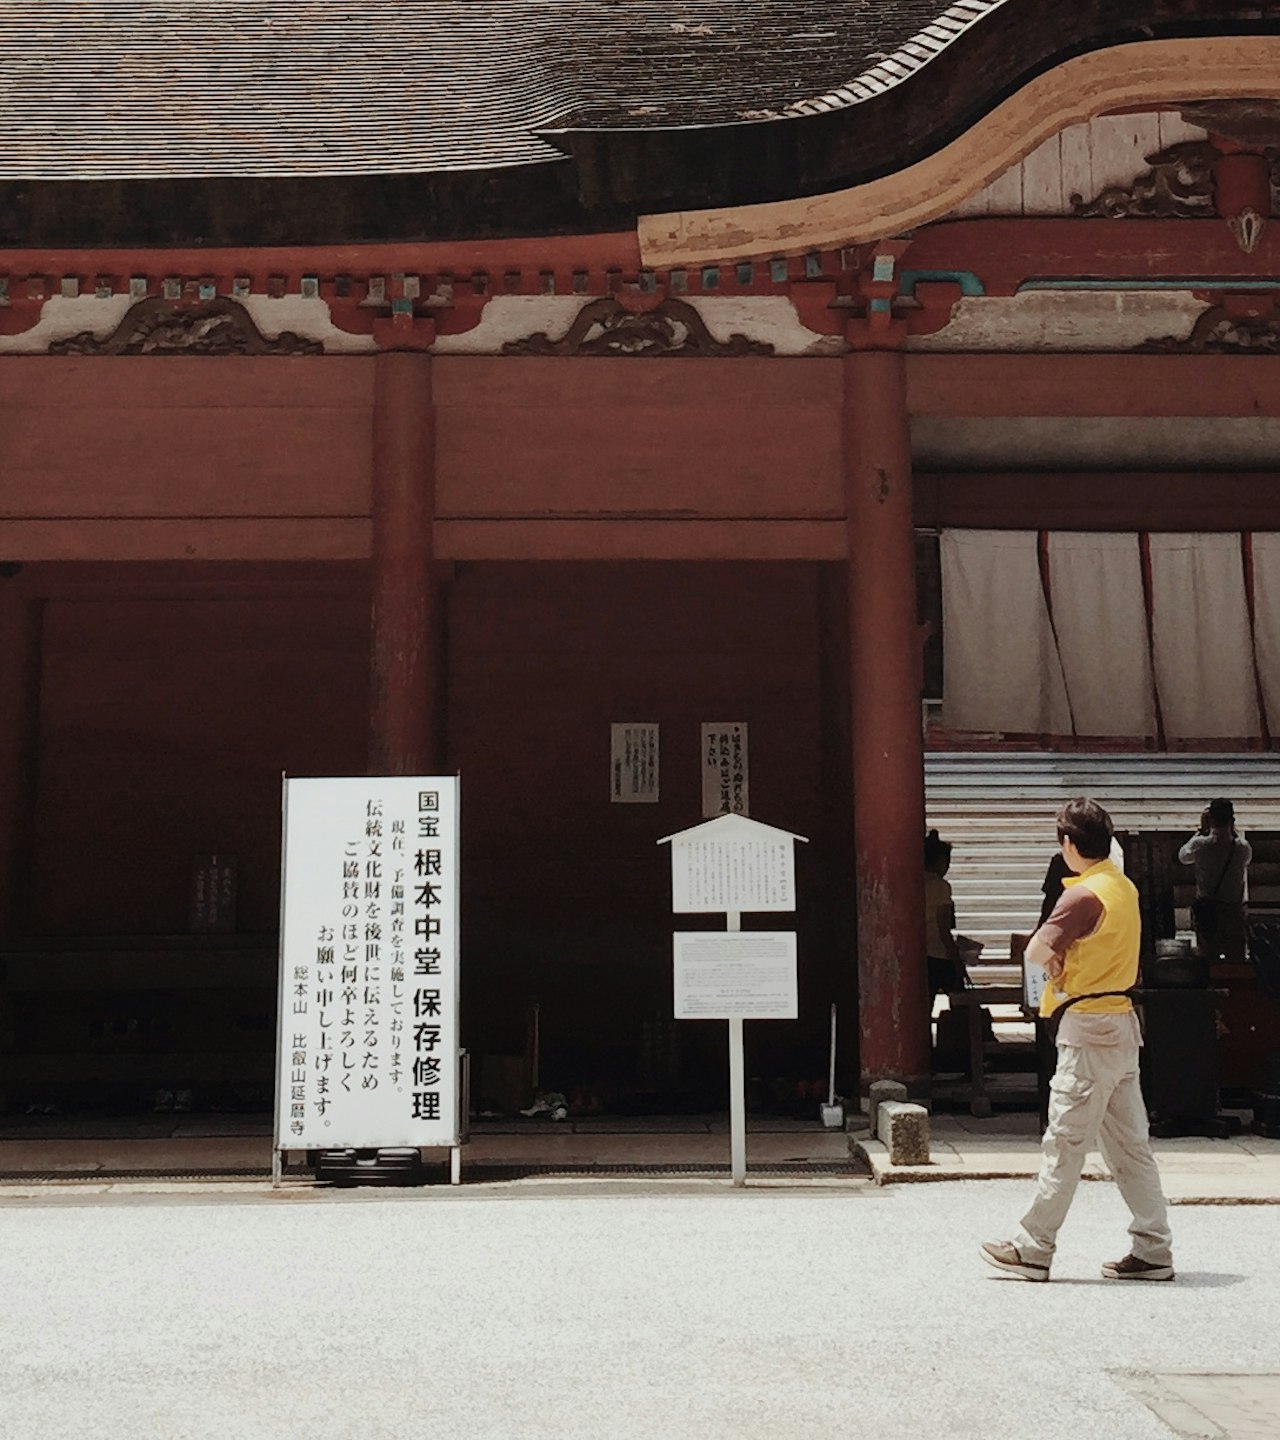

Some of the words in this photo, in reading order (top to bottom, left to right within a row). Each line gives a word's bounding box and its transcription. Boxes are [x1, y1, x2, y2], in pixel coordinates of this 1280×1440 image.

[418, 791, 440, 838] 国宝
[340, 841, 359, 1092] ご協賛のほど何卒よろしく
[361, 799, 384, 1091] 伝統文化財を後世に伝えるため
[388, 820, 406, 1092] 現在、予備調査を実施しております。
[413, 848, 442, 975] 根本中堂
[293, 966, 308, 1014] 総本山
[313, 926, 334, 1127] お願い申し上げます。
[411, 988, 442, 1120] 保存修理
[290, 1033, 307, 1136] 比叡山延暦寺
